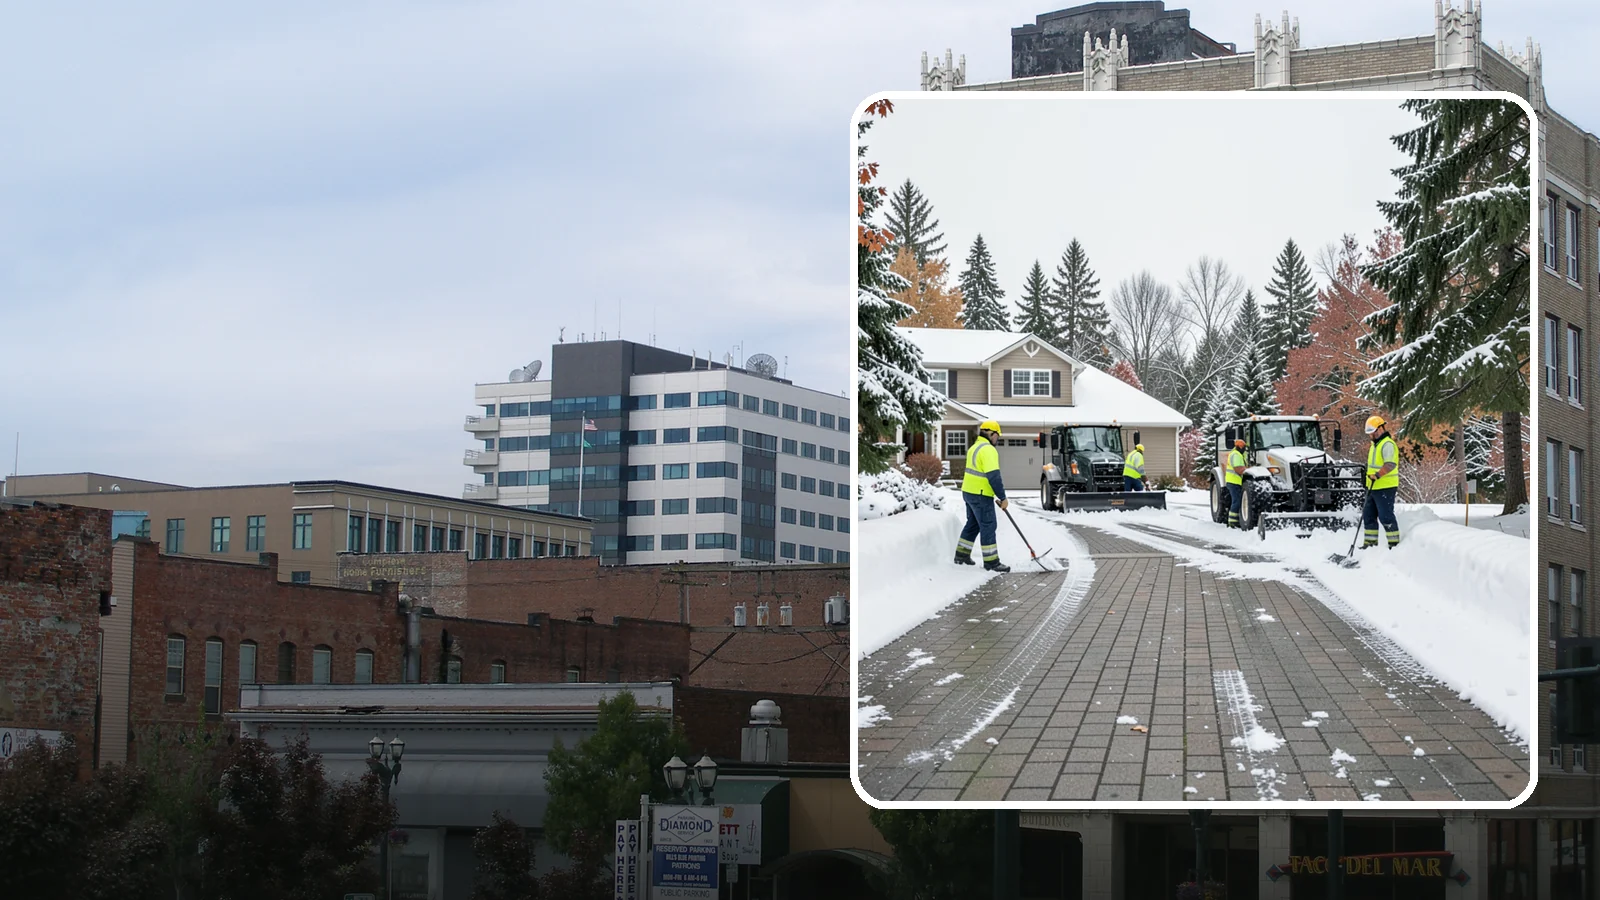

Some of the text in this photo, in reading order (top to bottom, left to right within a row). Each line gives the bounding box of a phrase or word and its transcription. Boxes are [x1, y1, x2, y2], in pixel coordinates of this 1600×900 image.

[370, 566, 427, 576] Furnishers
[660, 818, 713, 832] DIAMOND
[1022, 815, 1070, 828] BUILDING
[656, 845, 716, 854] RESERVED PARKING
[616, 825, 625, 894] PAY HERE
[627, 824, 637, 893] PAY HERE
[721, 851, 739, 862] Soup
[671, 862, 701, 870] PATRONS
[1346, 856, 1385, 876] DEL
[1392, 857, 1442, 877] MAR
[660, 889, 710, 898] PUBLIC PARKING
